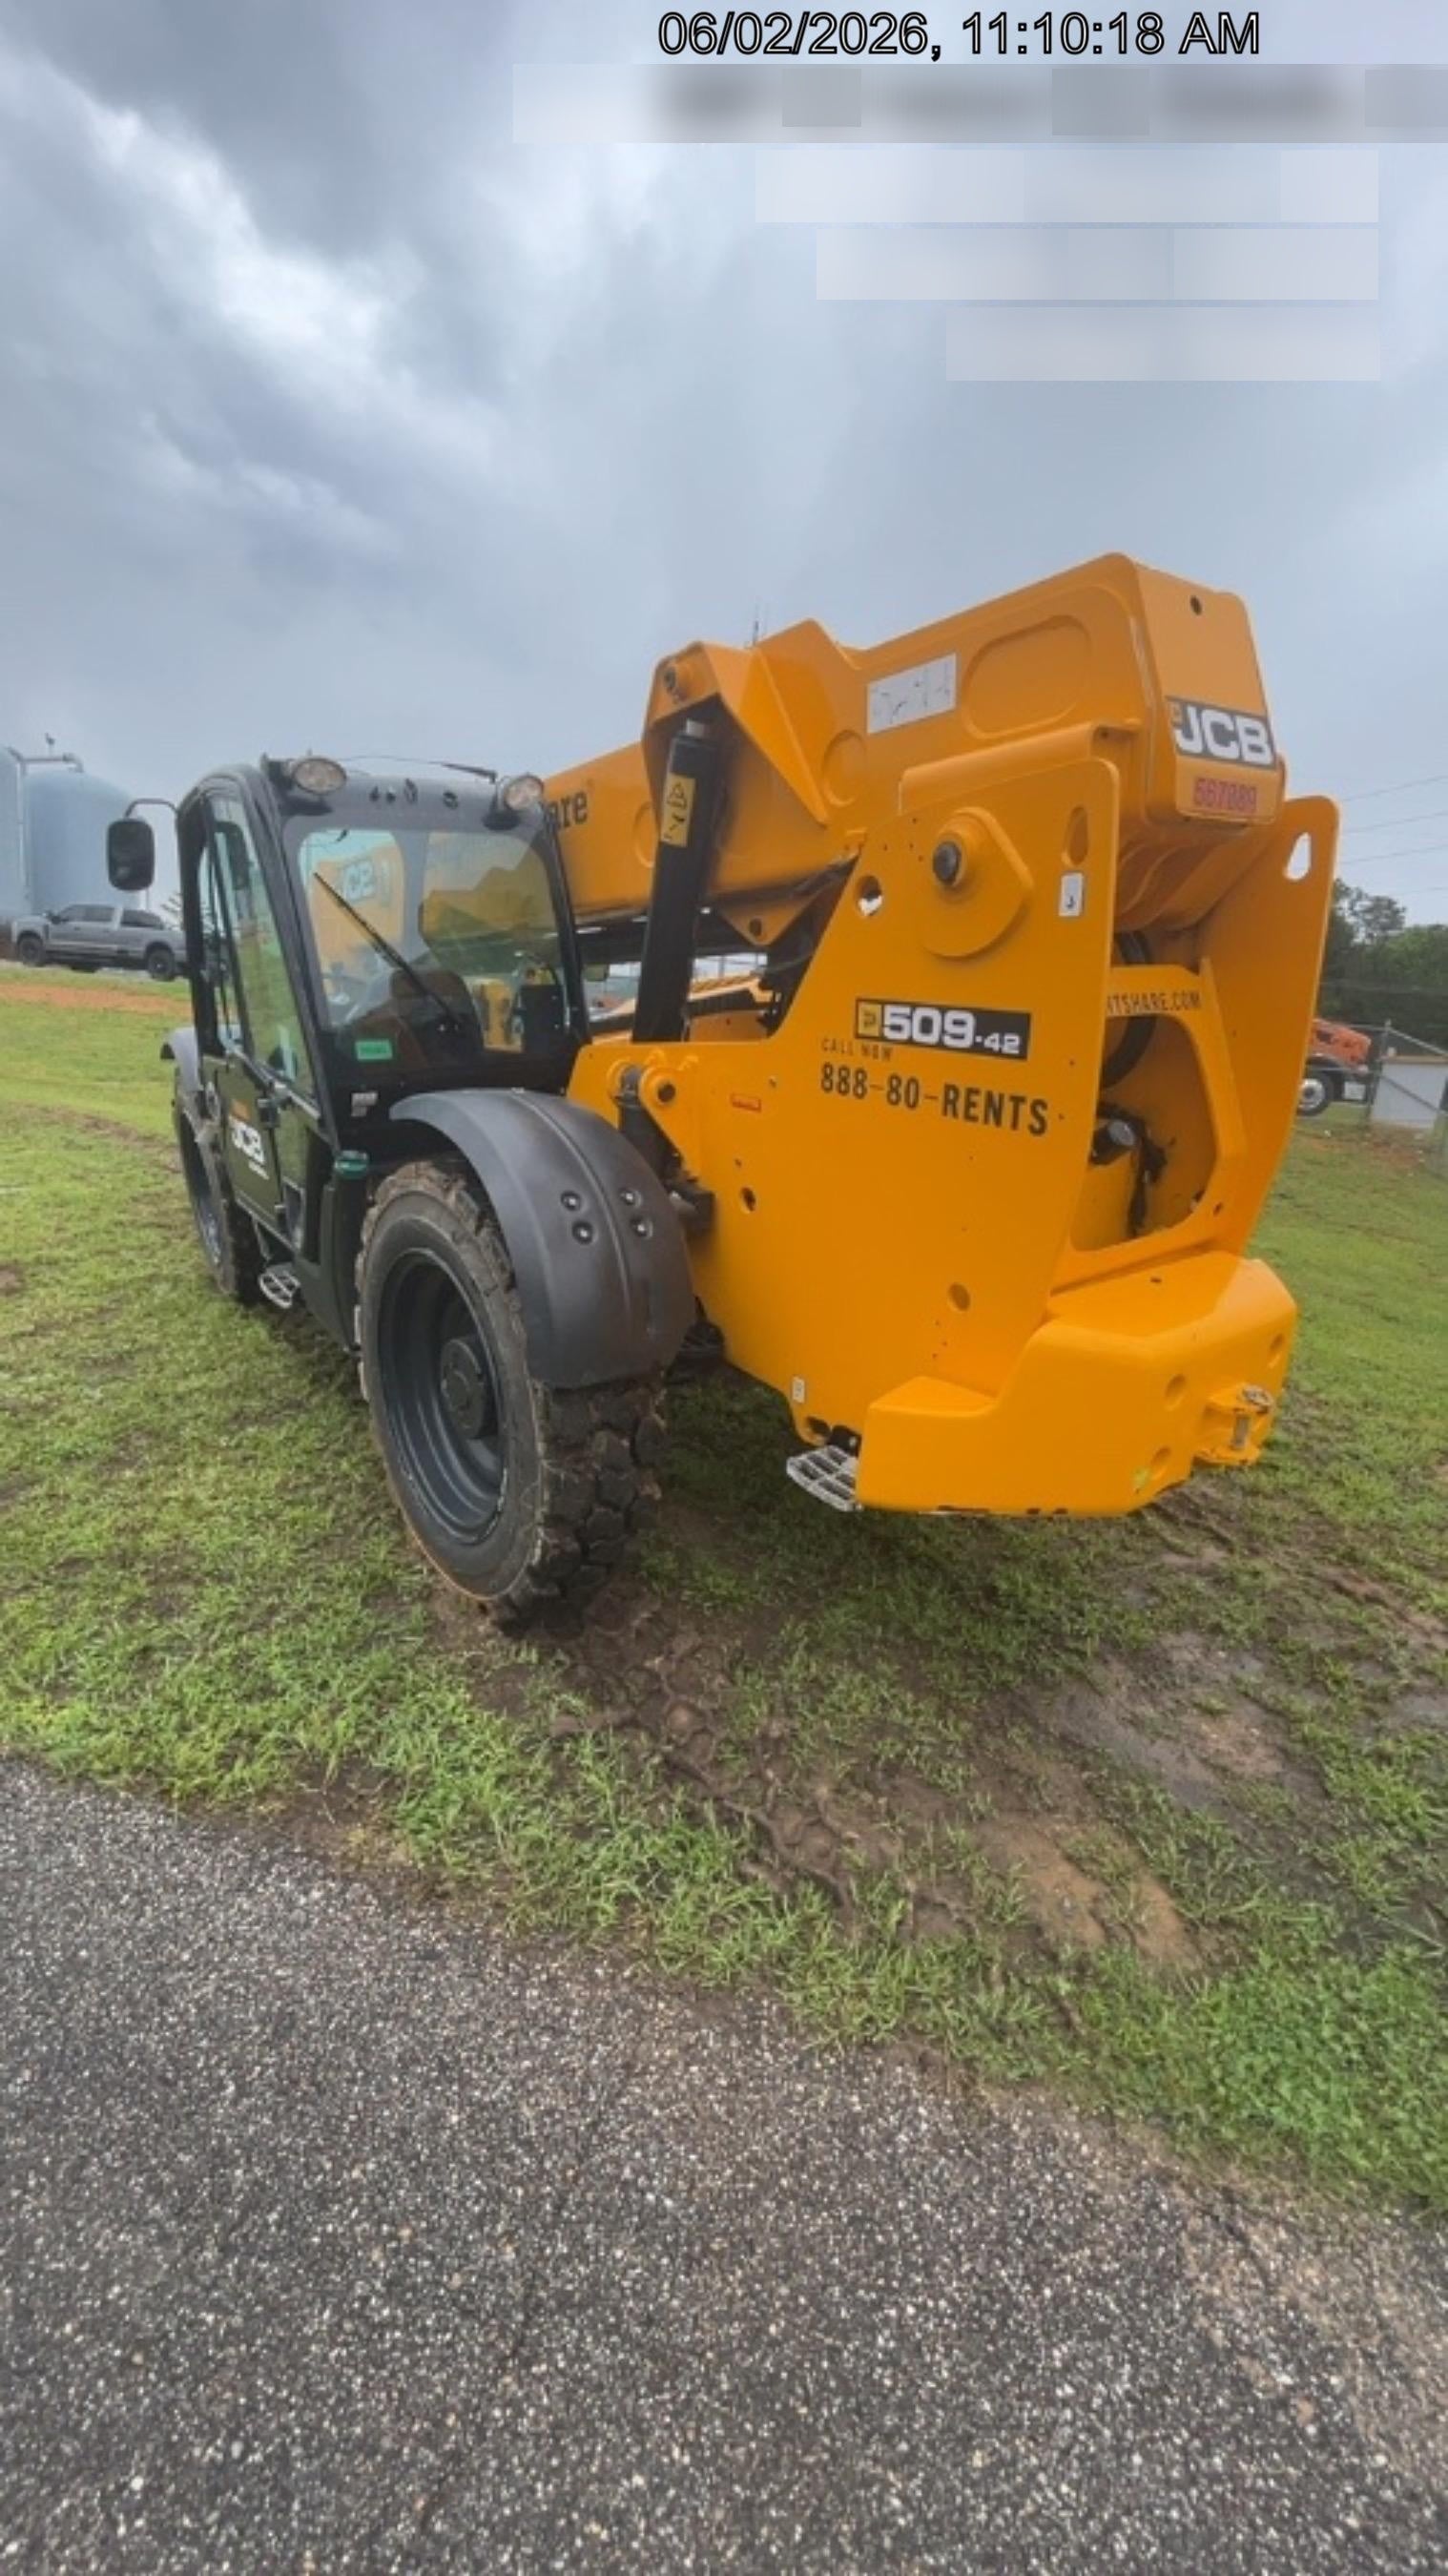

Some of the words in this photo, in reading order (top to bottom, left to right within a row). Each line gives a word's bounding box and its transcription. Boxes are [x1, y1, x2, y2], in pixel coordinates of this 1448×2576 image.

[1174, 705, 1274, 766] JCB
[822, 1037, 855, 1057] CALL
[820, 1061, 1048, 1136] 888-80-RENTS
